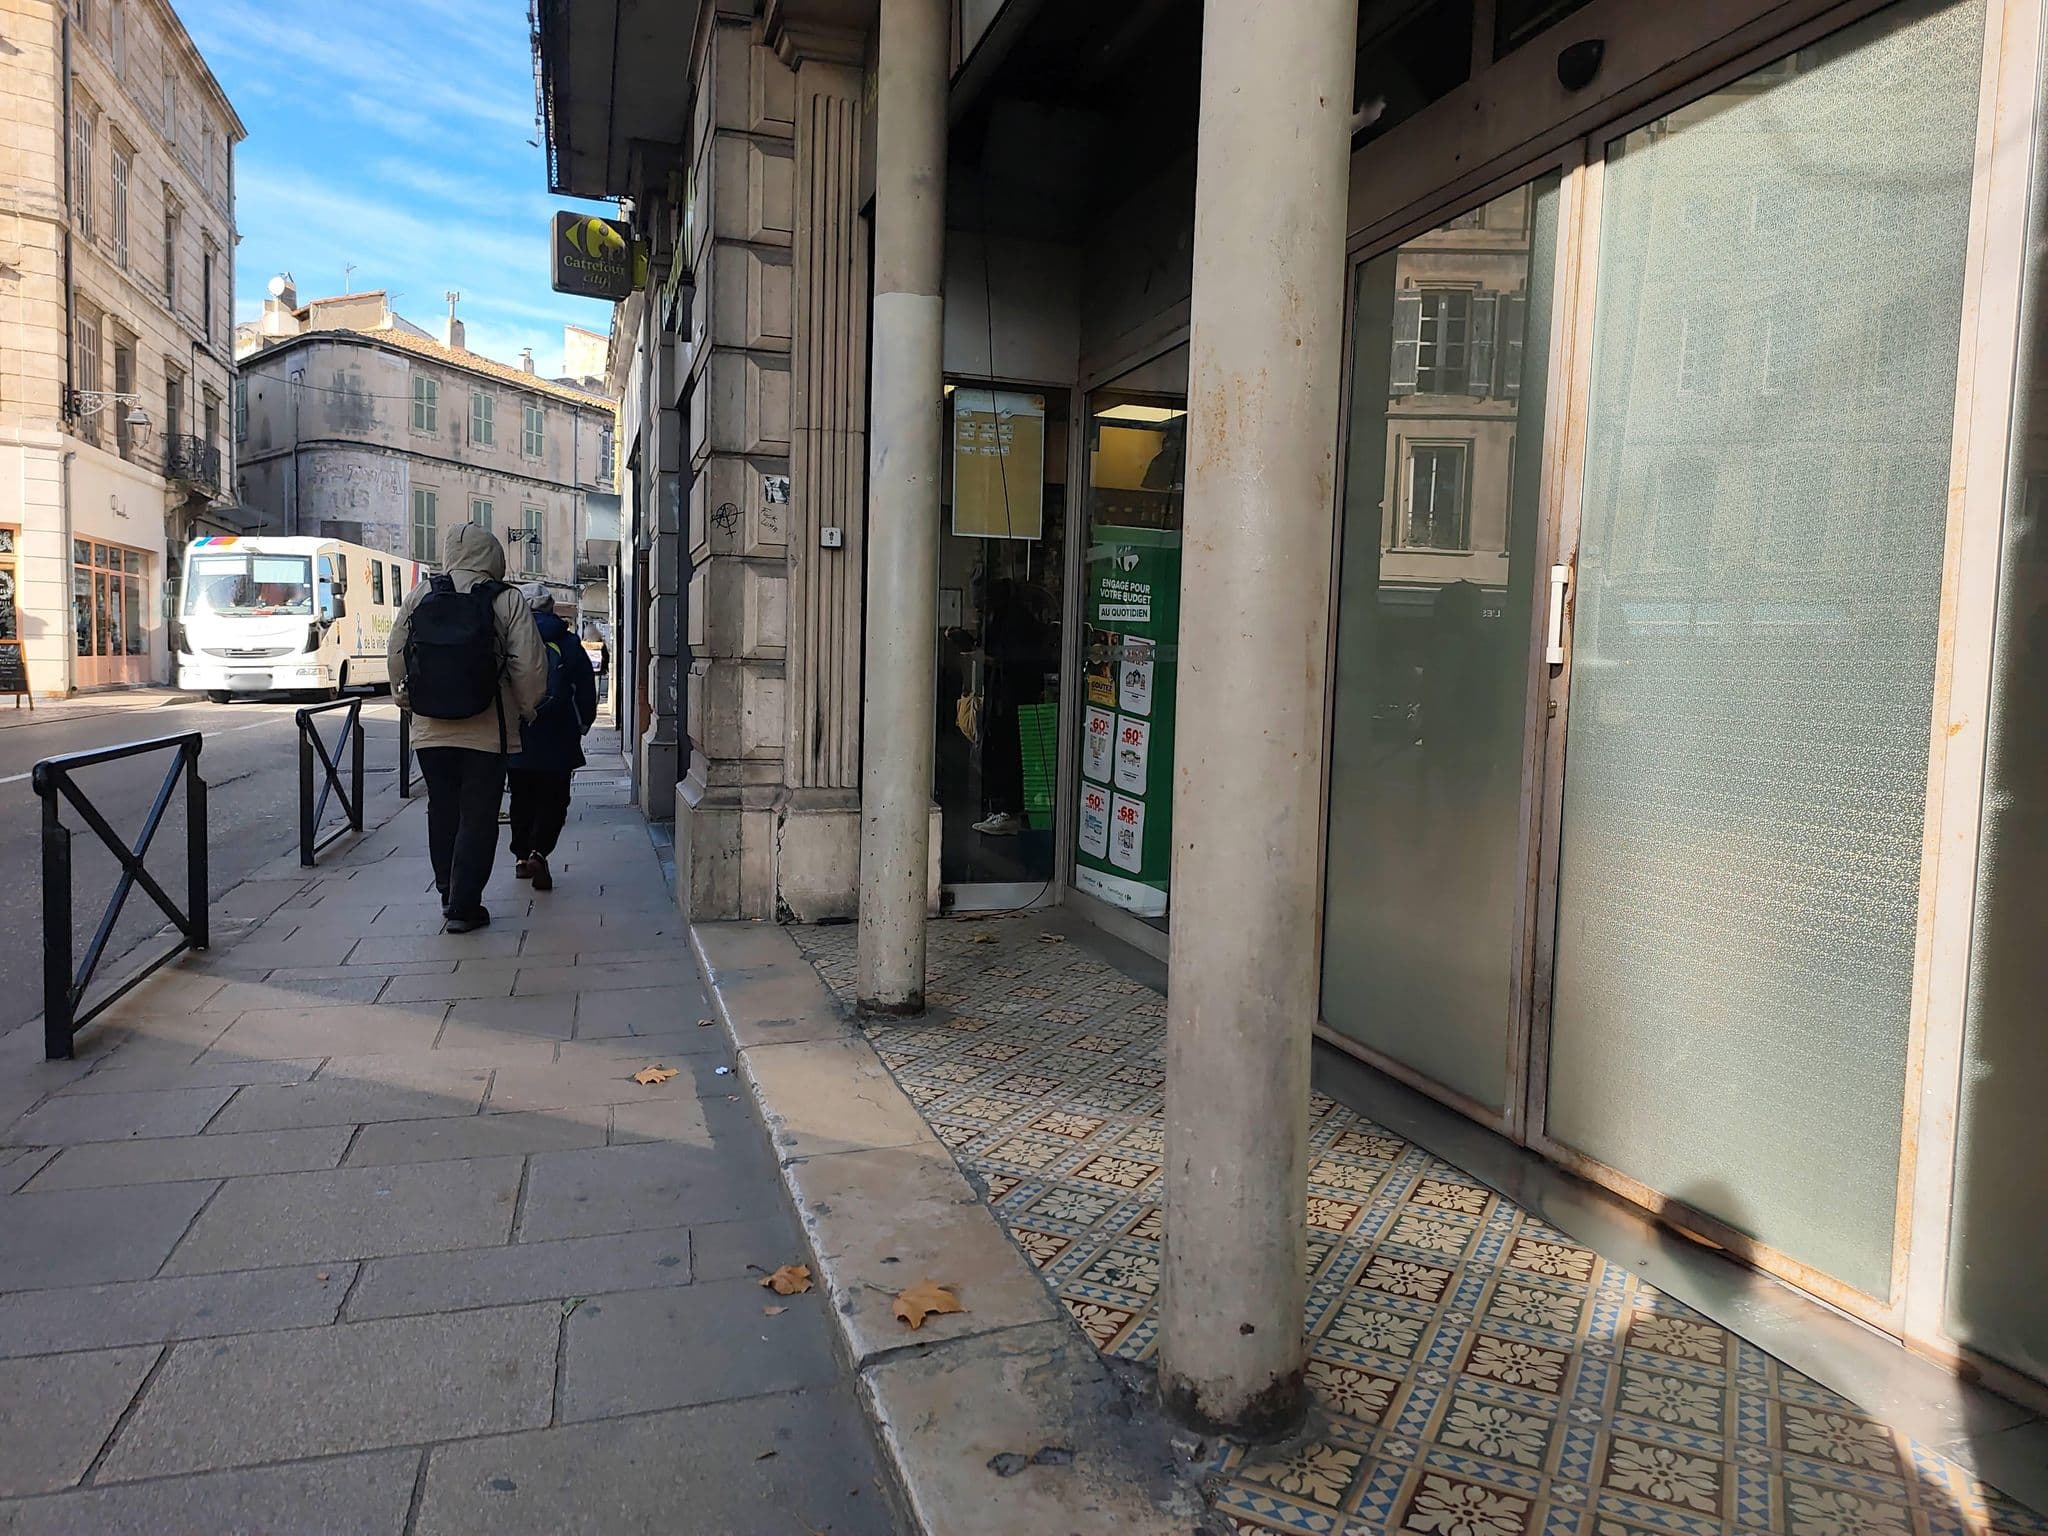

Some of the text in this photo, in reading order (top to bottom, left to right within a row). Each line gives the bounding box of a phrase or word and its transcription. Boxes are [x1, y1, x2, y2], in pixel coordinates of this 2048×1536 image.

[563, 255, 625, 276] Carrefour
[583, 272, 607, 290] city
[1102, 578, 1151, 594] ENGAGÉ POUR
[1100, 588, 1151, 604] VOTRE BUDGET
[1101, 608, 1148, 618] AU QUOTIDIEN
